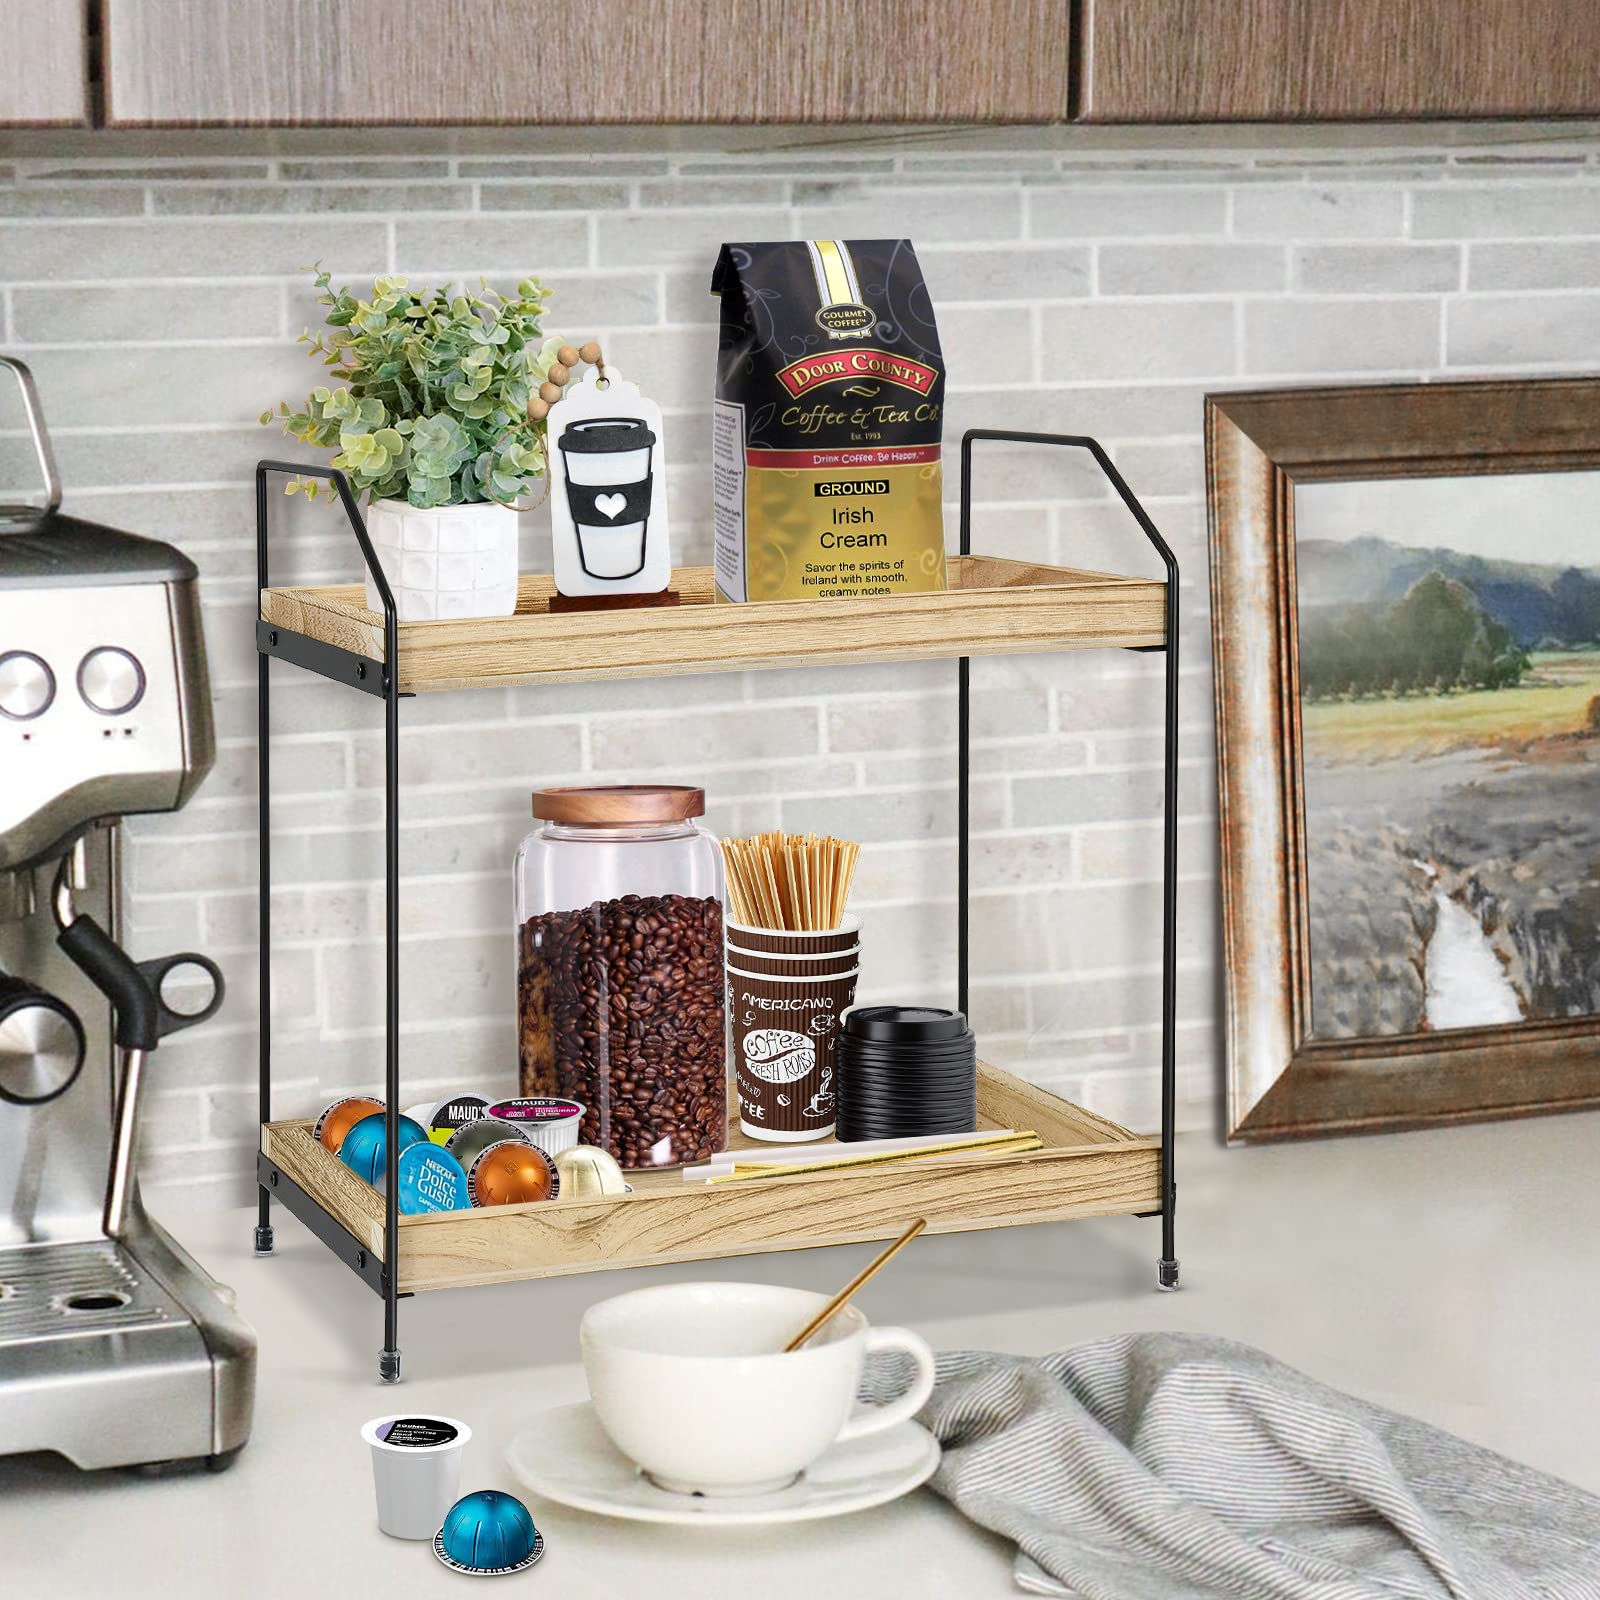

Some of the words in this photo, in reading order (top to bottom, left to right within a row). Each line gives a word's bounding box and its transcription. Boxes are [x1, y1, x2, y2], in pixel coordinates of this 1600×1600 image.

[823, 310, 866, 319] GOURMET
[781, 404, 847, 434] Coffee
[851, 408, 870, 429] &
[873, 404, 910, 424] Tea
[851, 432, 864, 441] Est.
[813, 455, 839, 464] Drink
[877, 452, 889, 462] Be
[819, 481, 887, 496] GROUND
[832, 507, 874, 525] Irish
[820, 532, 887, 549] Cream
[805, 563, 837, 573] Savor
[839, 562, 856, 572] the
[859, 560, 890, 572] spirits
[893, 560, 905, 569] of
[801, 575, 838, 585] Ireland
[840, 574, 862, 584] with
[861, 586, 891, 595] notes
[741, 991, 834, 1012] AMERICANO
[750, 1061, 781, 1081] FRESH
[784, 1050, 816, 1079] ROAST
[419, 1165, 457, 1200] Dolce
[417, 1178, 455, 1210] Gusto
